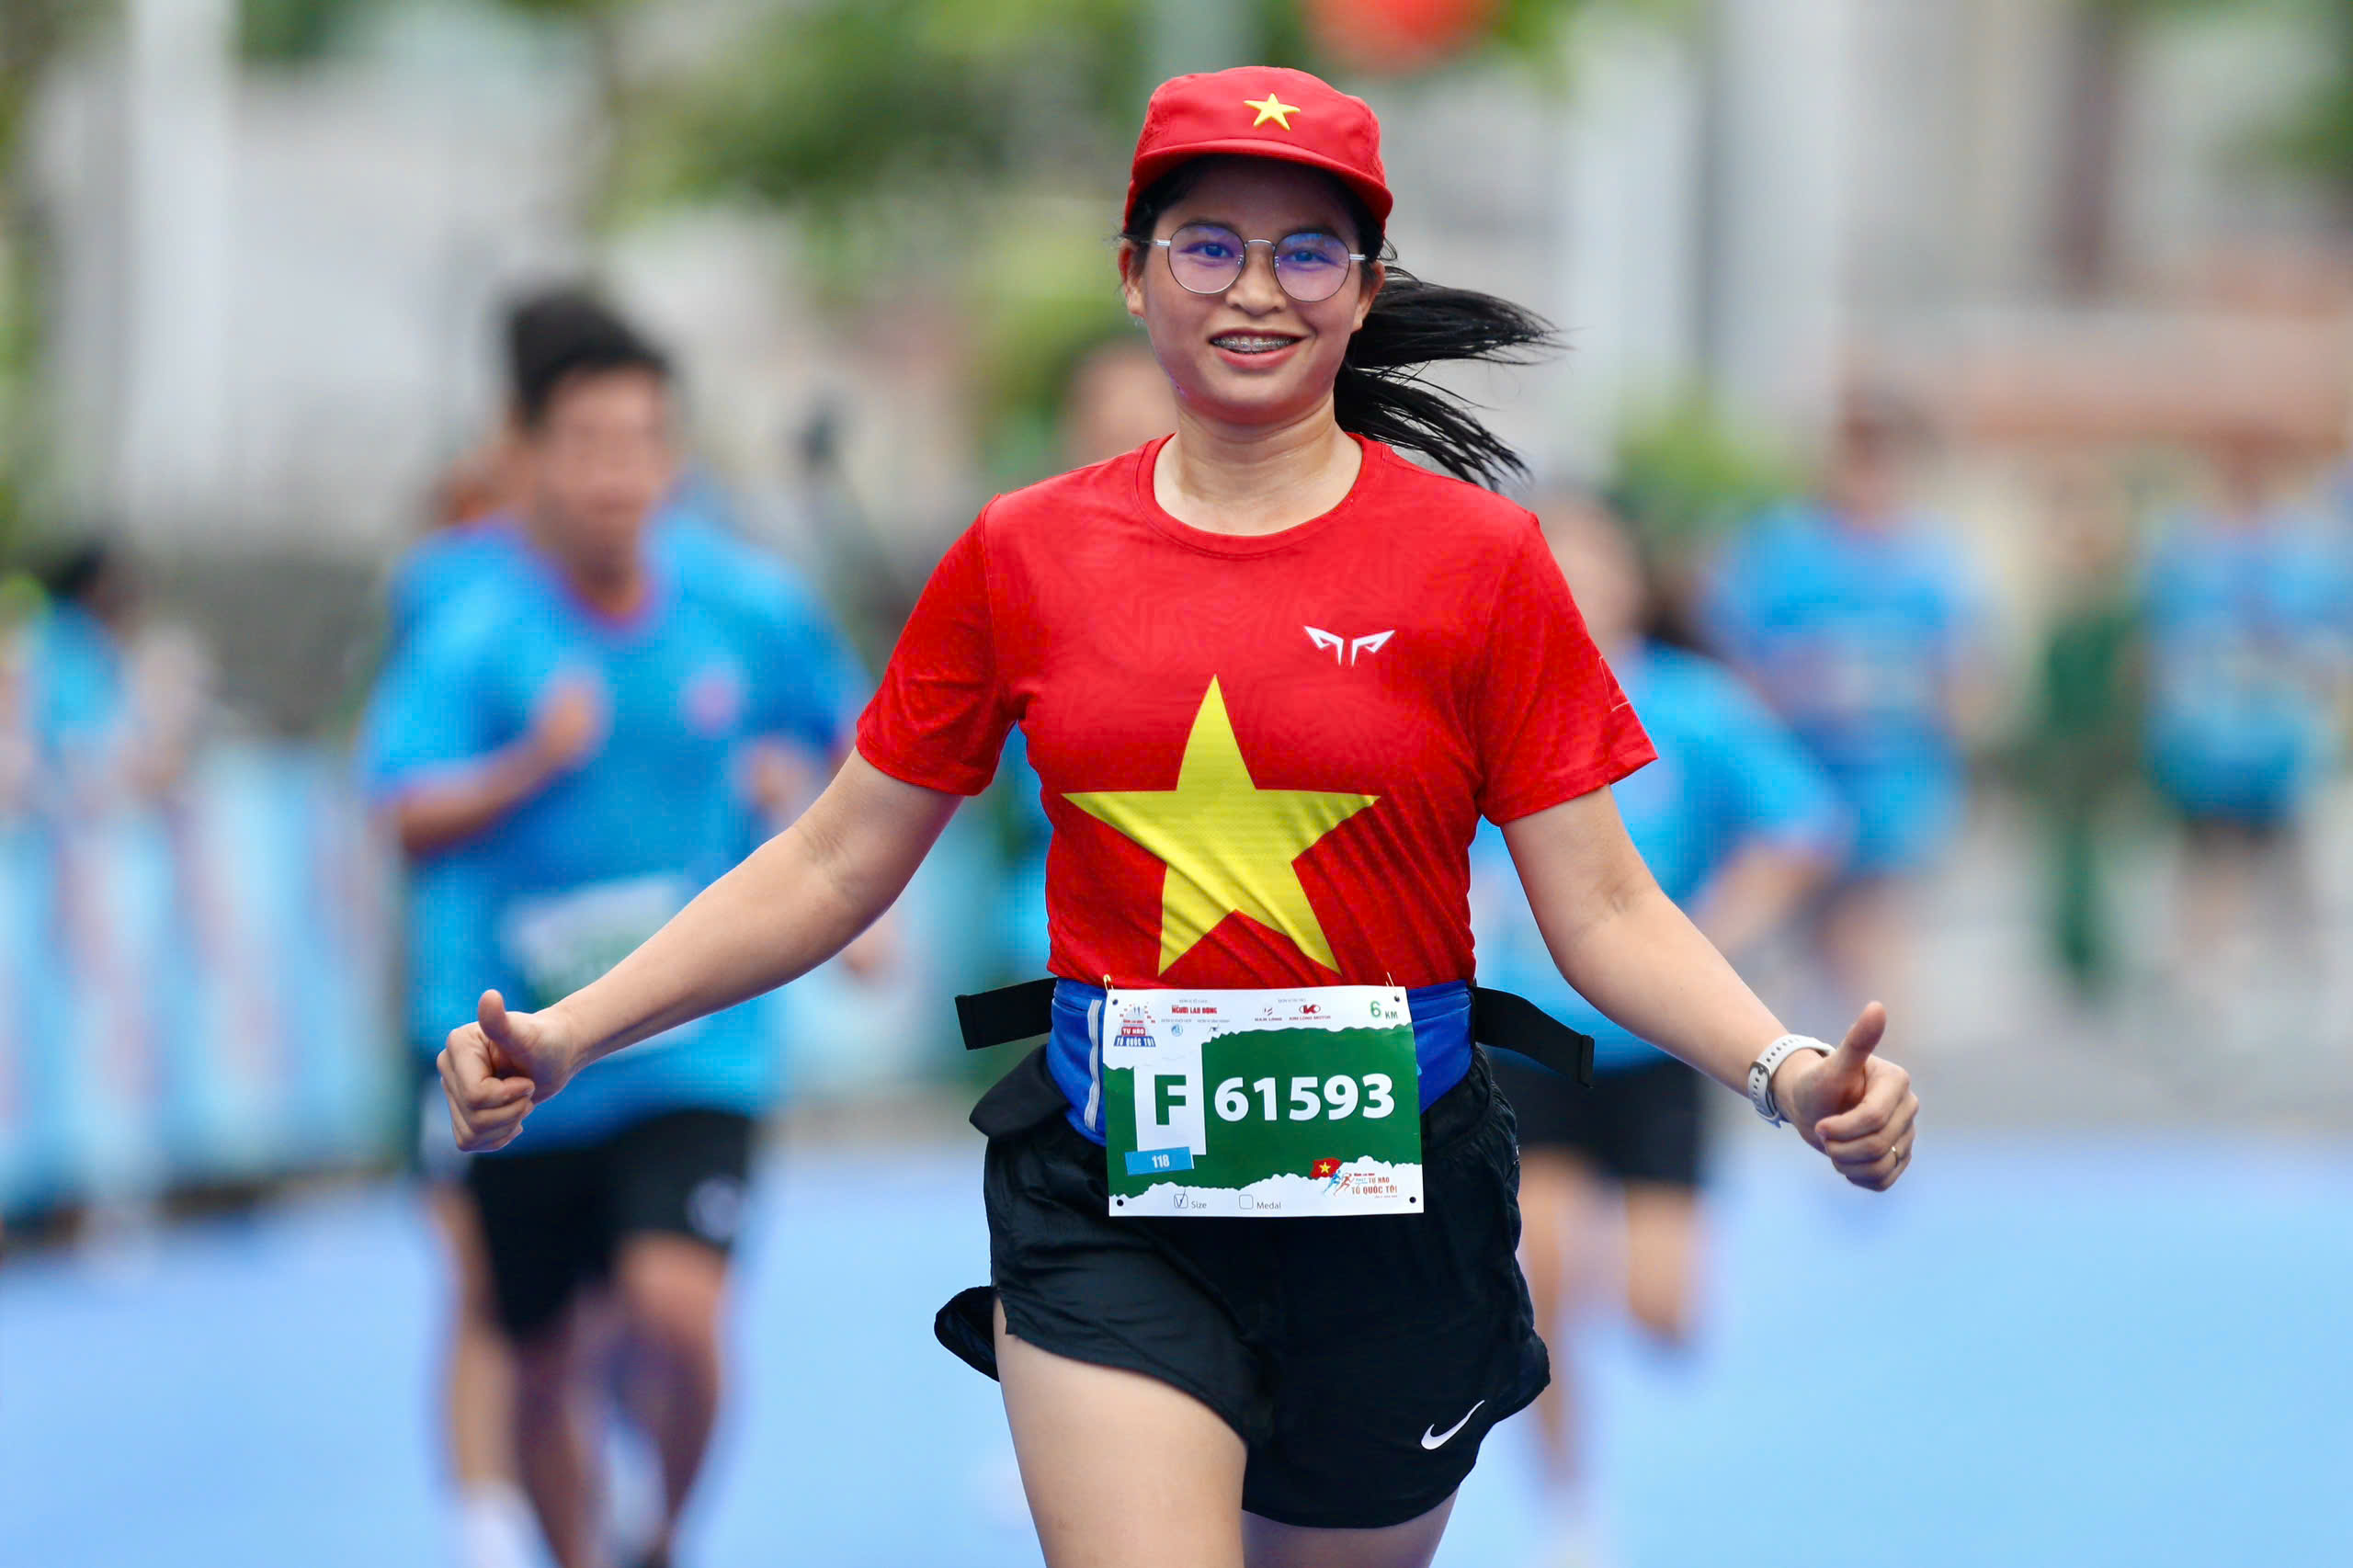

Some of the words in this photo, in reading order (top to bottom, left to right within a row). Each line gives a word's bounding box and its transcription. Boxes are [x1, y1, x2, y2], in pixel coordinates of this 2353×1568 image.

[1370, 1000, 1381, 1017] 6
[1384, 1010, 1398, 1019] KM
[1154, 1074, 1187, 1125] F
[1214, 1073, 1394, 1122] 61593
[1151, 1153, 1170, 1169] 118
[1190, 1200, 1207, 1210] Size
[1256, 1200, 1281, 1210] Medal
